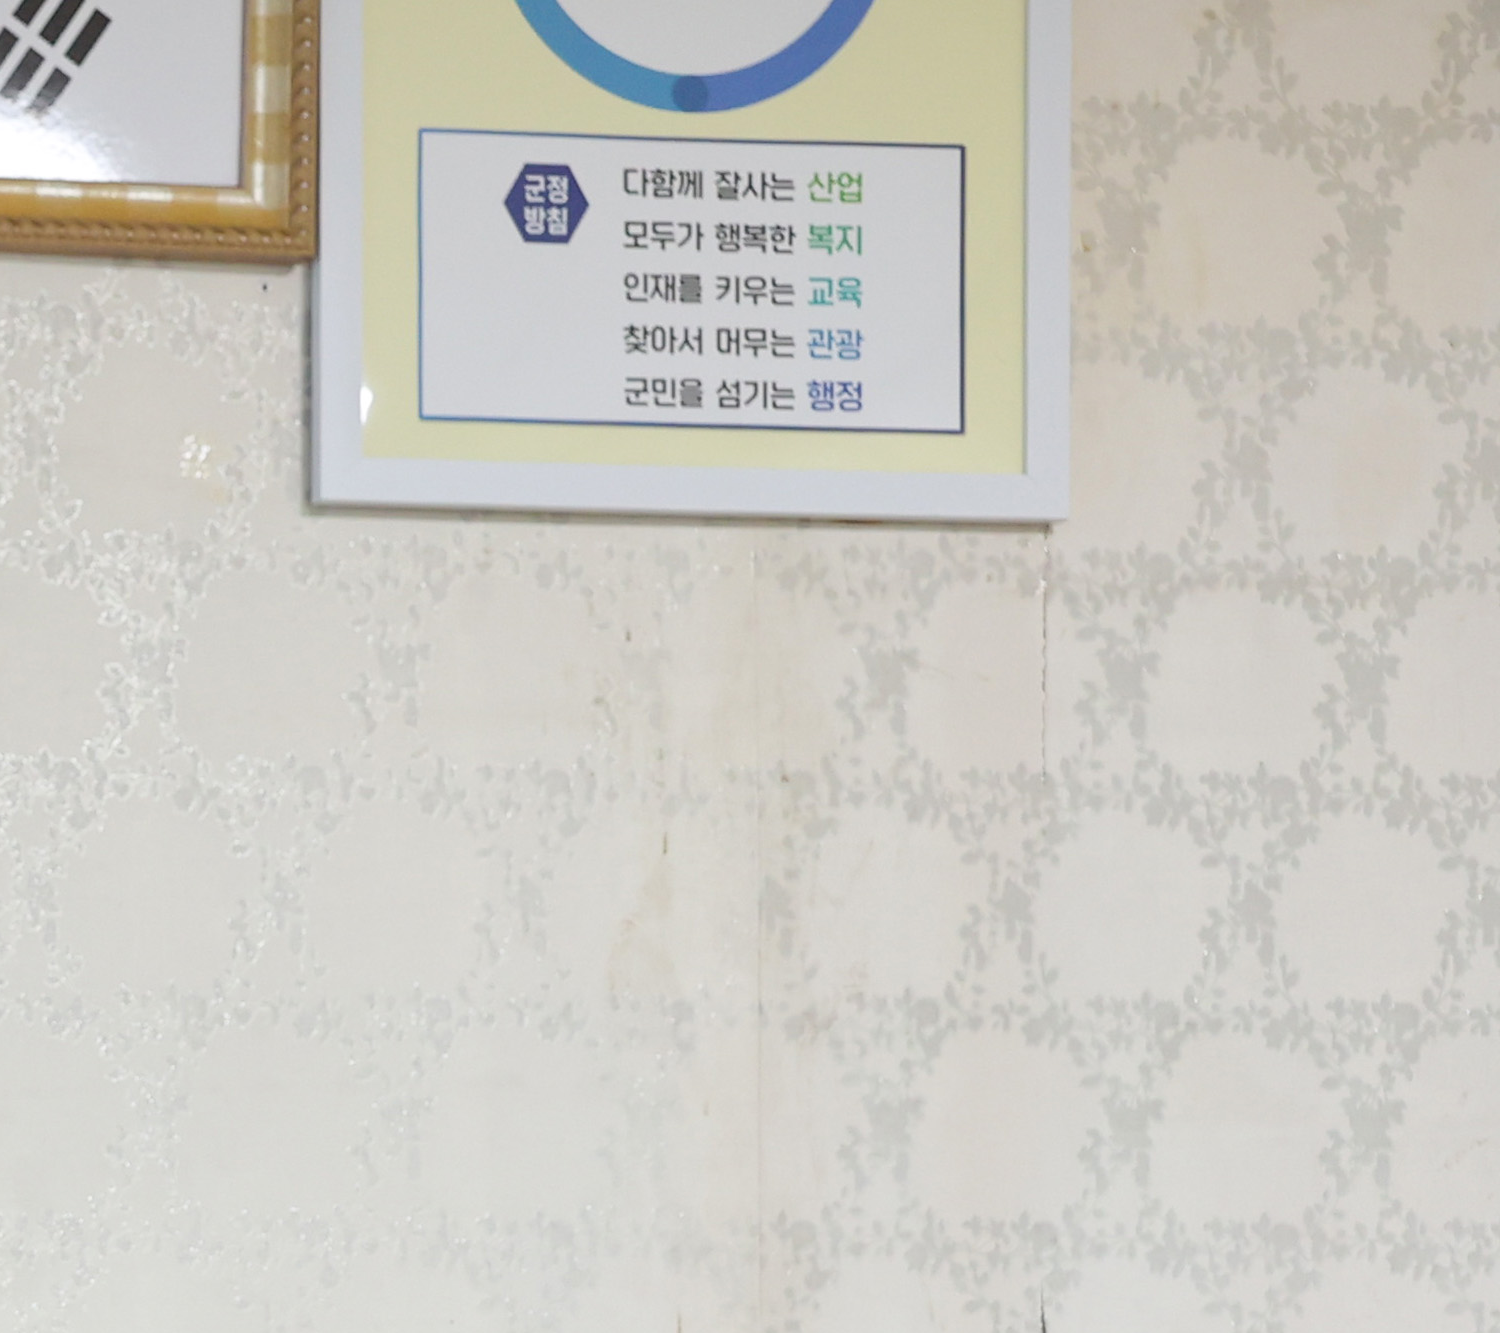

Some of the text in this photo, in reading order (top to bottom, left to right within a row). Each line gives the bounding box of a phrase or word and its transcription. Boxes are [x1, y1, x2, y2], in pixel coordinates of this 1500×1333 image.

[524, 174, 569, 205] 군정
[623, 168, 864, 204] 다함께 잘사는 산업
[524, 206, 569, 236] 방침
[623, 221, 864, 256] 모두가 행복한 복지
[623, 272, 863, 308] 인재를 키우는 교육
[623, 324, 865, 361] 찾아서 머무는 관광
[624, 376, 863, 413] 군민을 섬기는 행정
